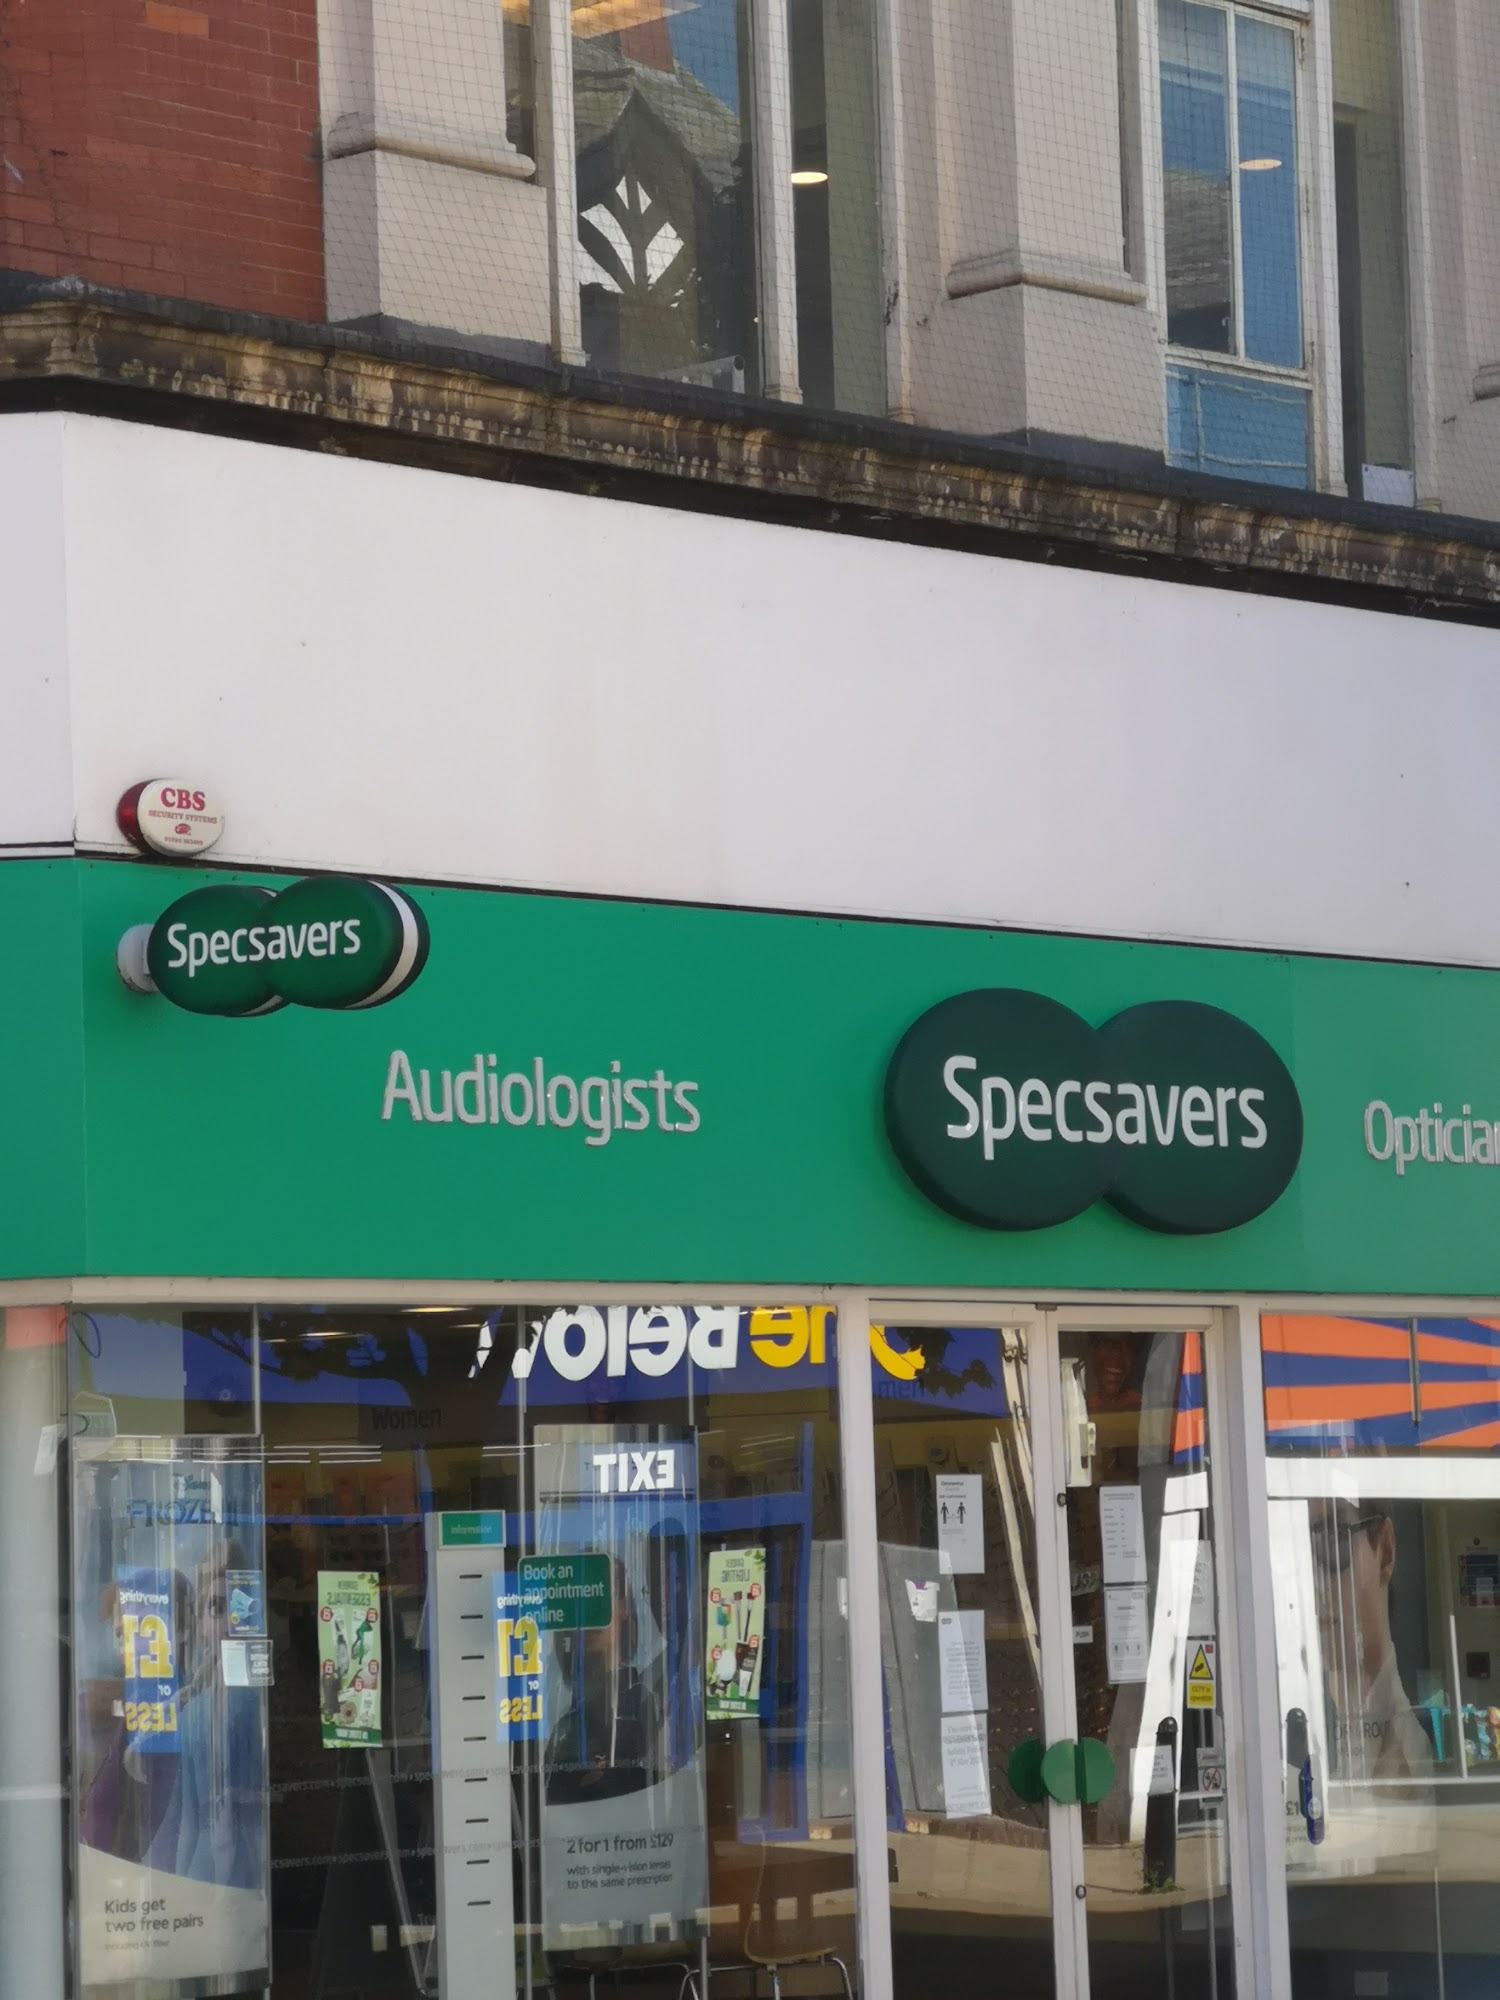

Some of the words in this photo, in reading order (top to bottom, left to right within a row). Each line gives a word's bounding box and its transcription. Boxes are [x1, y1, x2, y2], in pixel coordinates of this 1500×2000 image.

[160, 786, 206, 812] CBS
[148, 809, 184, 821] SECURITY
[185, 814, 218, 825] SYSTEMS
[167, 918, 362, 978] Specsavers
[380, 1049, 702, 1148] Audiologists
[942, 1053, 1268, 1161] Specsavers
[523, 1562, 556, 1581] Book
[557, 1565, 574, 1579] an
[524, 1581, 605, 1601] appointment
[566, 1838, 576, 1854] 2
[577, 1836, 602, 1854] for
[613, 1835, 647, 1851] from
[104, 1899, 137, 1915] Kids
[141, 1897, 166, 1915] get
[105, 1919, 137, 1934] two
[140, 1916, 170, 1932] free
[173, 1912, 205, 1933] pairs
